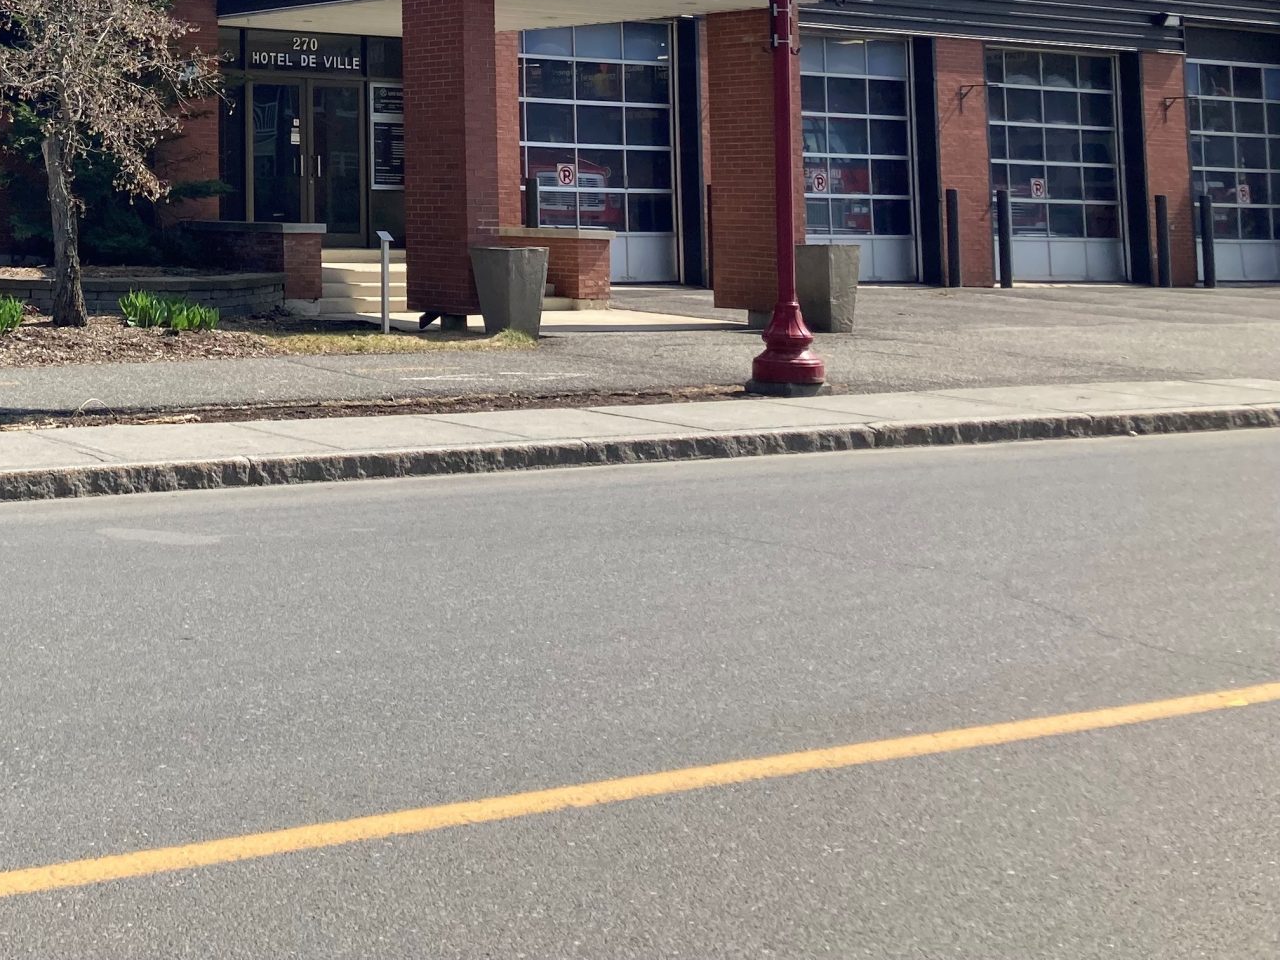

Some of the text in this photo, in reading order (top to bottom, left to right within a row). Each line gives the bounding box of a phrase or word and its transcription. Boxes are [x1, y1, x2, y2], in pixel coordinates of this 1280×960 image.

[293, 37, 318, 51] 270
[252, 51, 360, 70] HOTEL DE VILLE
